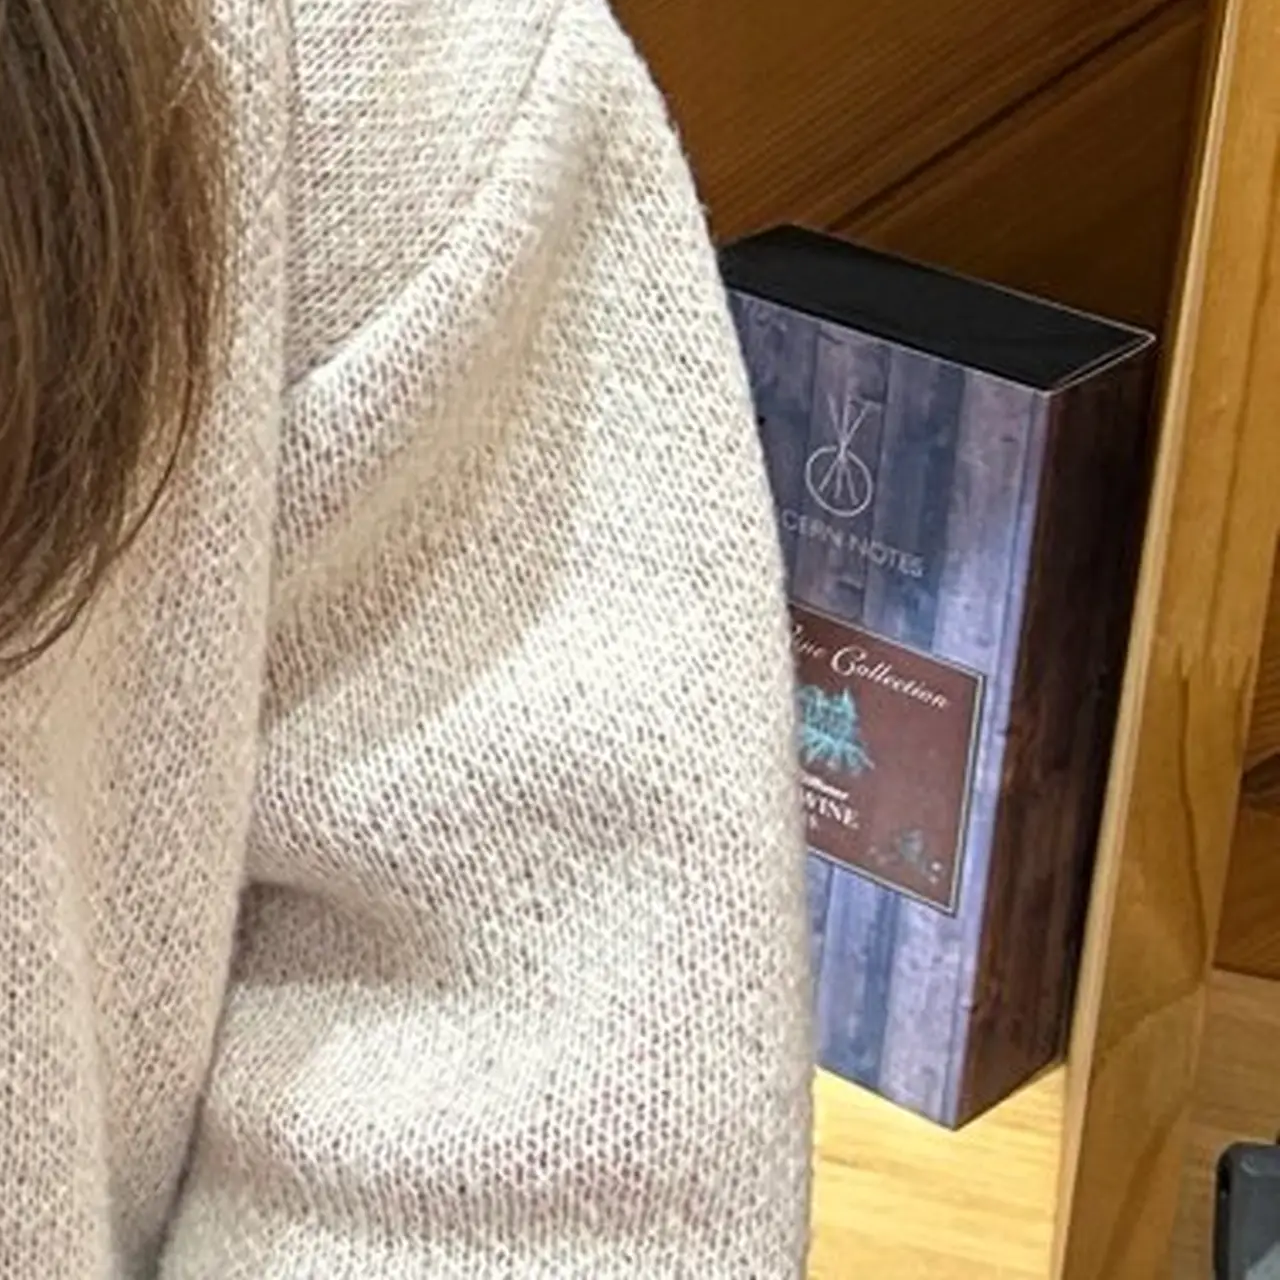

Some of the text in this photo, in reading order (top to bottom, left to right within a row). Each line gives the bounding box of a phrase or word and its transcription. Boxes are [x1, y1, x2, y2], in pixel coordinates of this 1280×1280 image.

[780, 507, 926, 578] CERN NOTES
[830, 644, 950, 710] Collection
